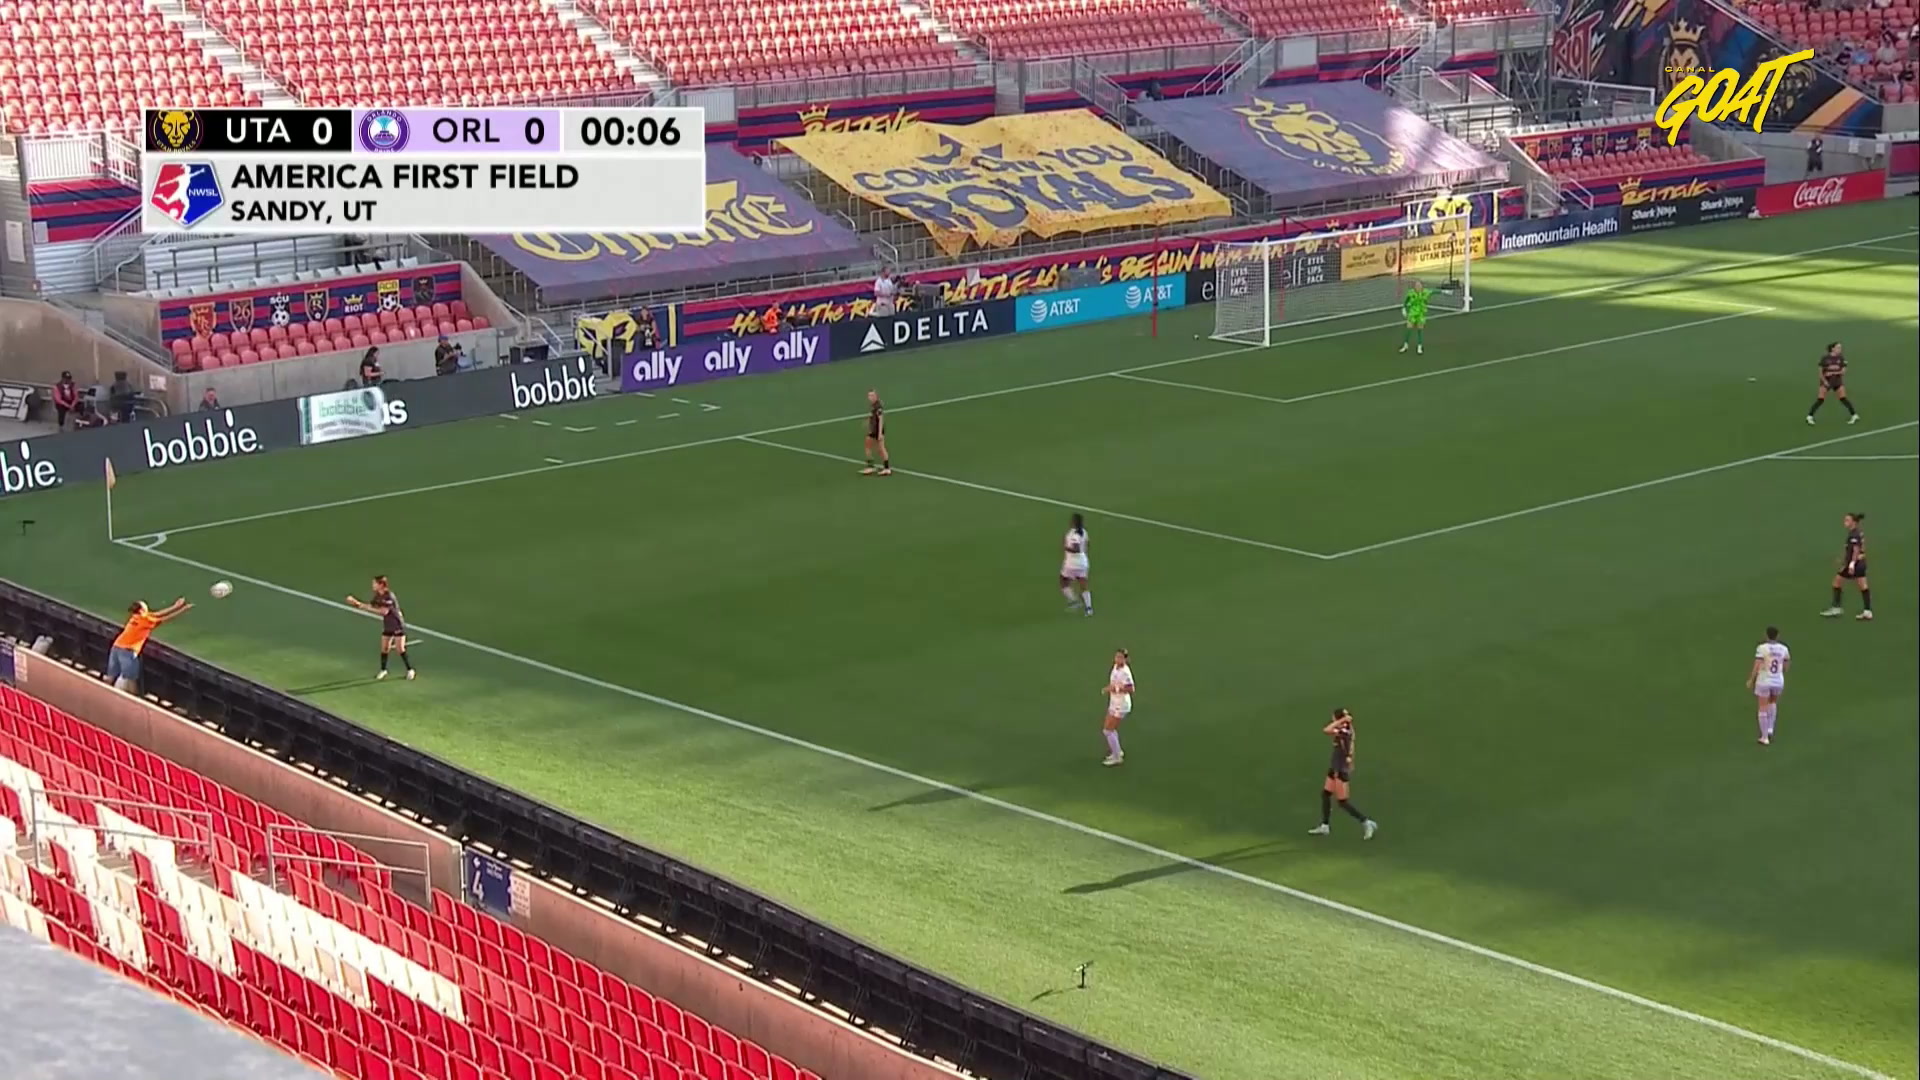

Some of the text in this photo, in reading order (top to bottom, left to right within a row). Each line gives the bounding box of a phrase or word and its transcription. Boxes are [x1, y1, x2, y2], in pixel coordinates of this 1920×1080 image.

[853, 166, 981, 192] COME
[1037, 144, 1134, 168] YOU
[884, 165, 1196, 231] ROYALS
[1501, 224, 1580, 250] Intermountain
[1582, 217, 1618, 237] Health
[345, 304, 364, 313] RIOT
[1049, 298, 1081, 317] AT&T
[1143, 284, 1173, 303] AT&T
[893, 308, 989, 345] DELTA
[704, 340, 752, 375] ally
[772, 330, 819, 365] ally
[633, 350, 683, 385] ally
[1770, 659, 1779, 674] 8
[472, 870, 485, 901] 4
